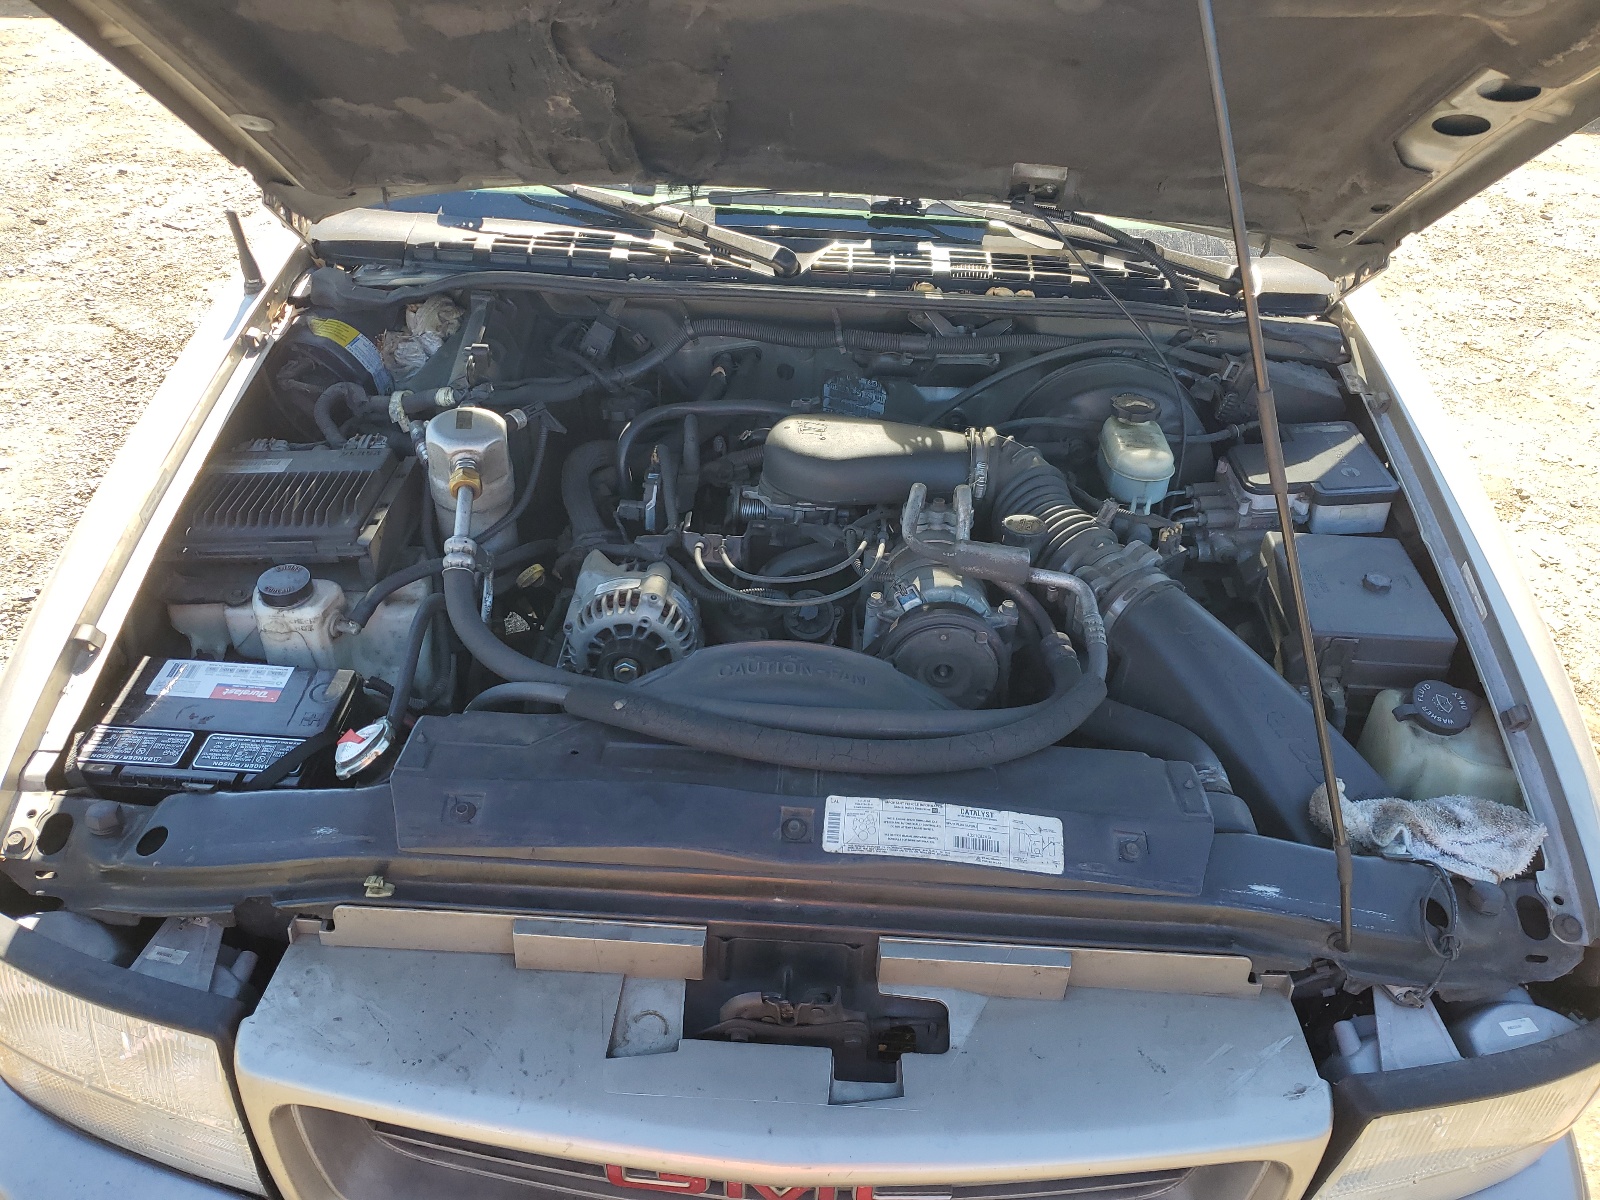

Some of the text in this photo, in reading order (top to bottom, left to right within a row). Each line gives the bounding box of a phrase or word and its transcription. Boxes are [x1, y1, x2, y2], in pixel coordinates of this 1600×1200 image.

[718, 660, 813, 678] CAUTION
[222, 688, 269, 698] Duralast
[1417, 683, 1455, 725] WASHER FLUID
[1452, 691, 1468, 710] ONLY
[212, 761, 270, 769] ANGER/POISON
[960, 808, 994, 818] CATALYST
